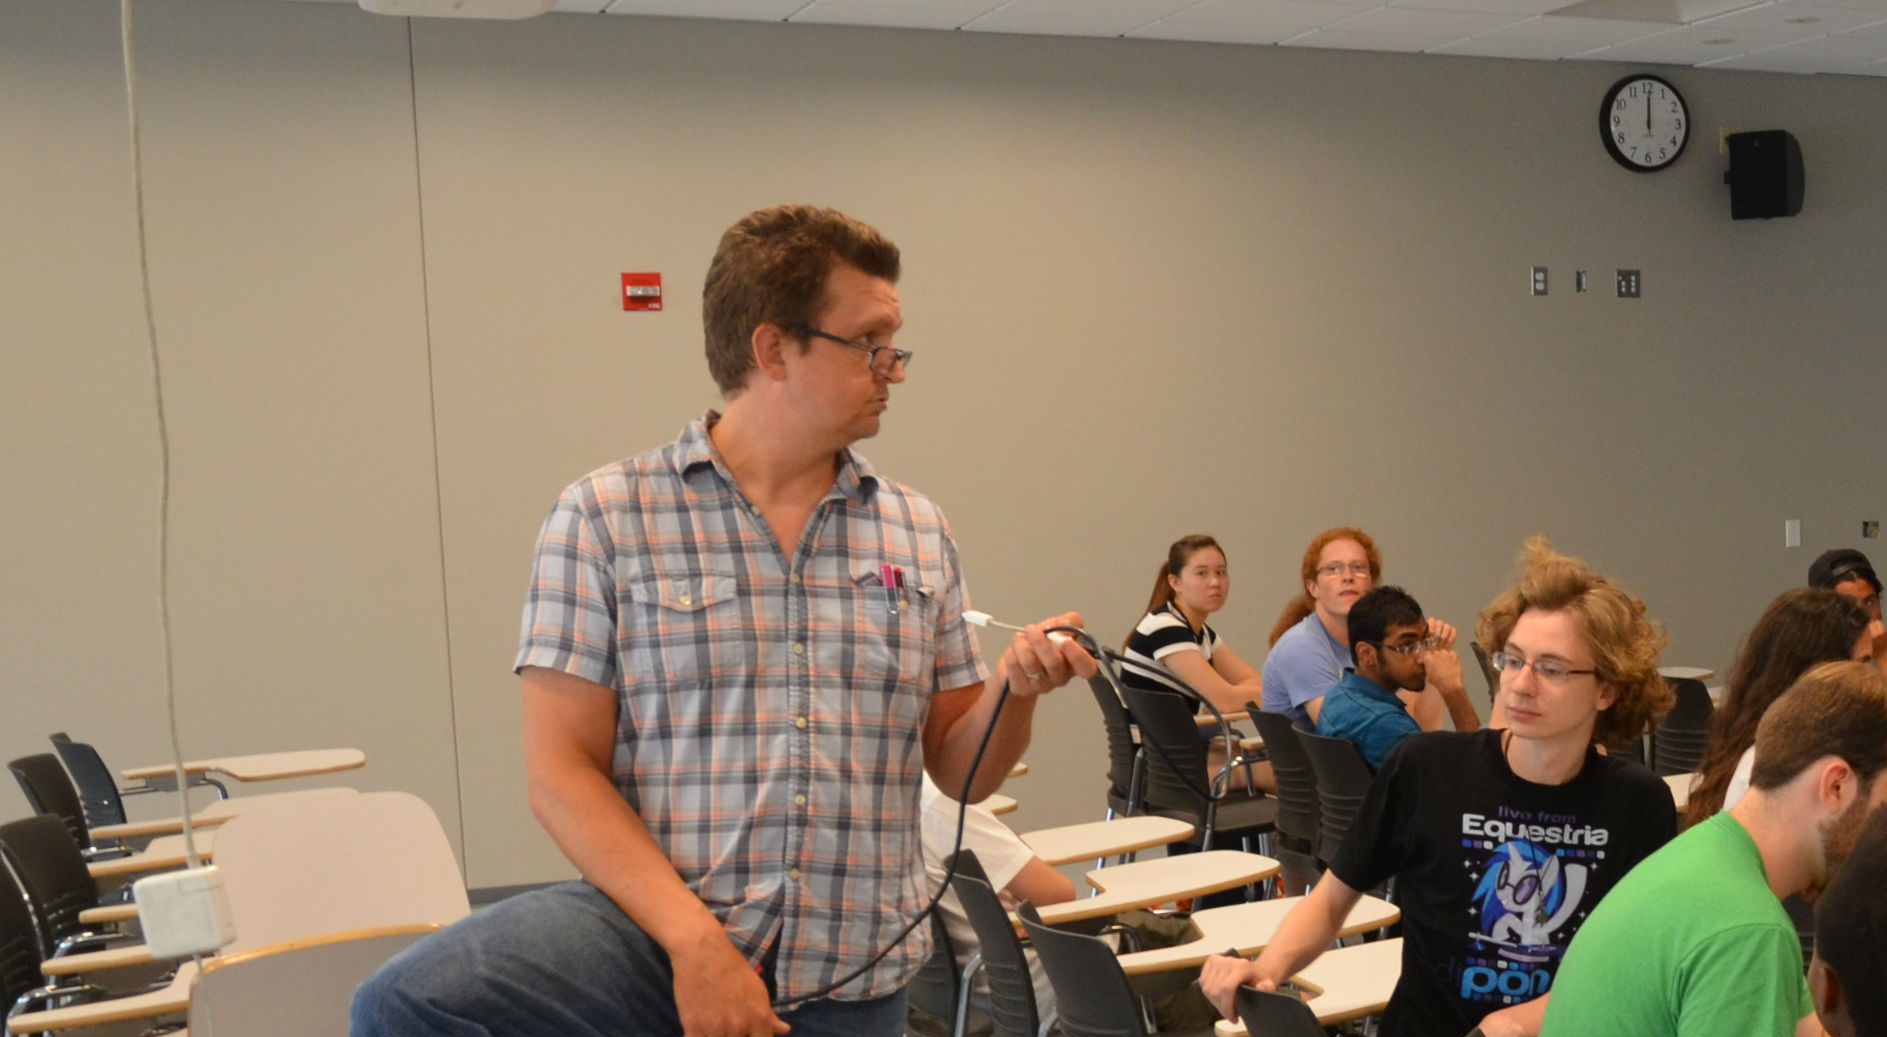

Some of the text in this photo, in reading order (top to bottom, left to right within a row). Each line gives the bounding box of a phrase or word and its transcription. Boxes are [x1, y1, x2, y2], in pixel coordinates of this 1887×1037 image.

[1498, 805, 1577, 825] live from
[1461, 812, 1610, 847] Equestria
